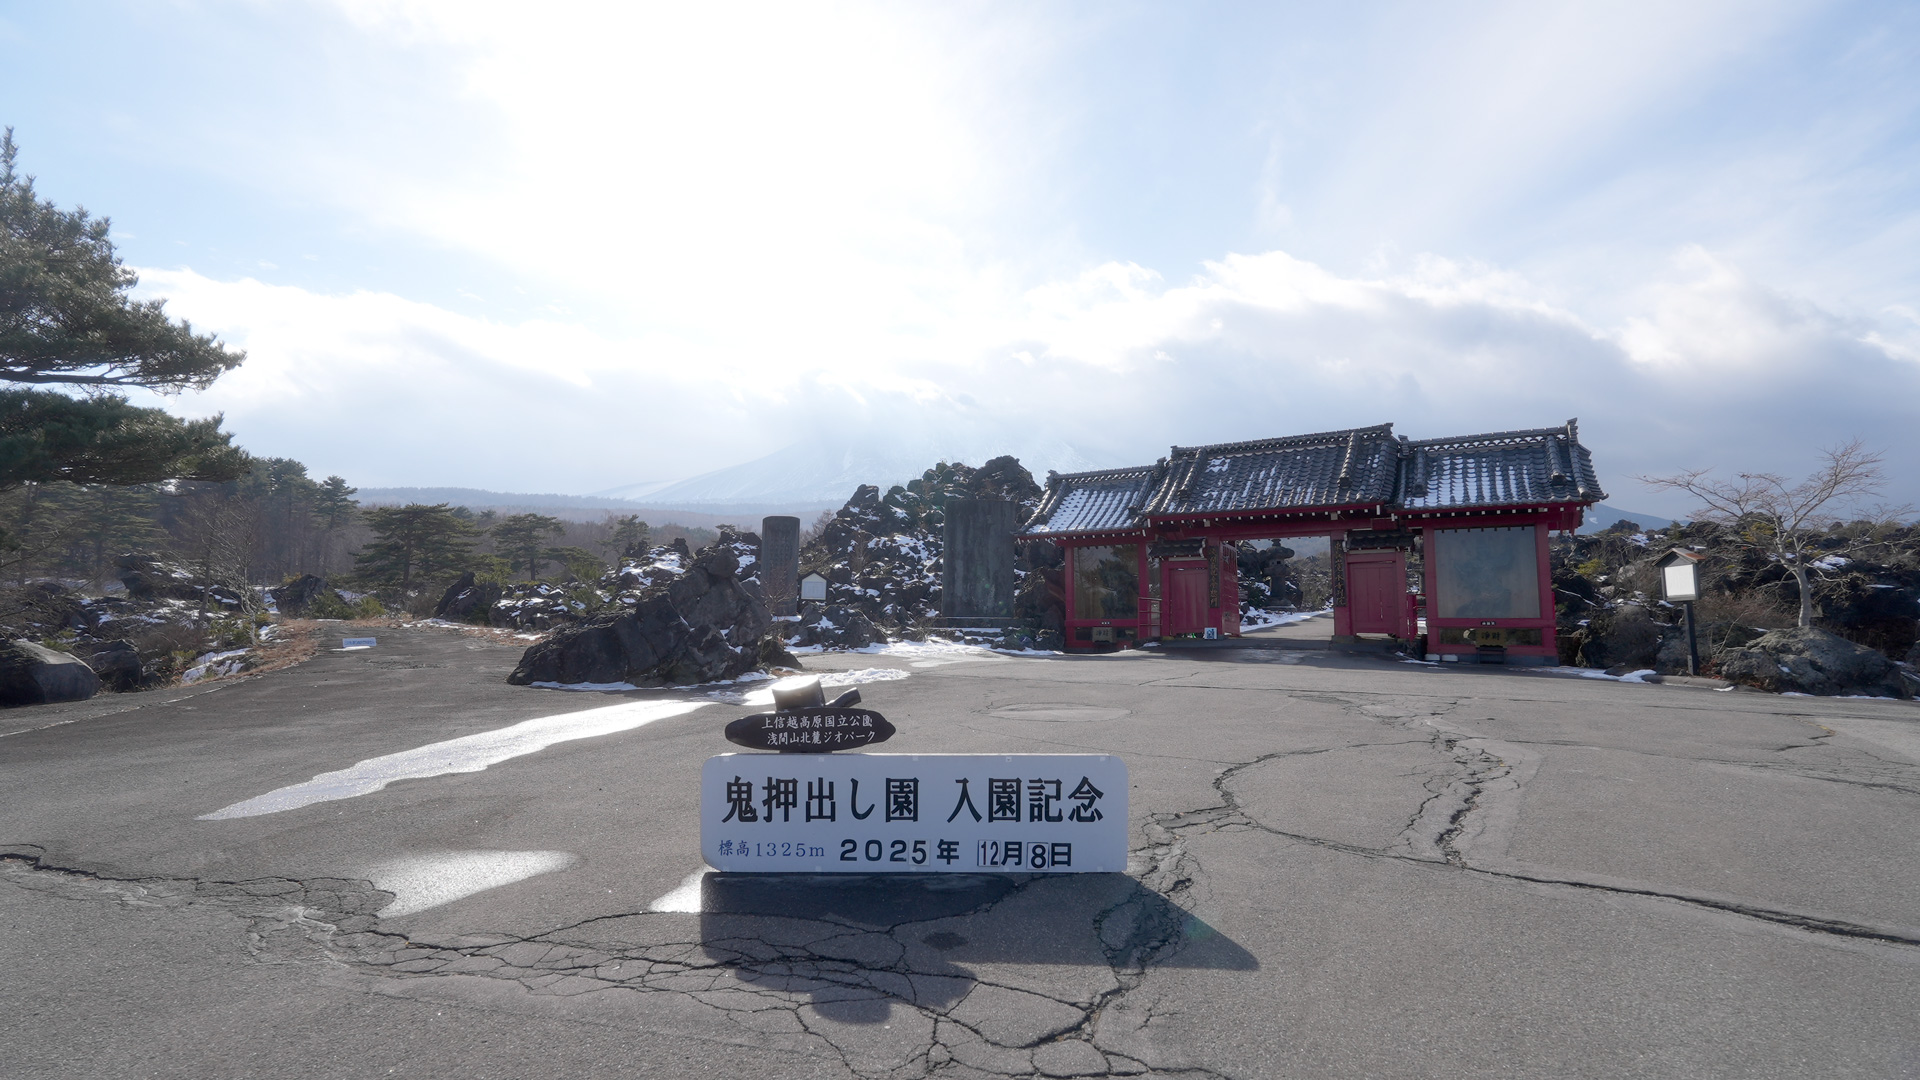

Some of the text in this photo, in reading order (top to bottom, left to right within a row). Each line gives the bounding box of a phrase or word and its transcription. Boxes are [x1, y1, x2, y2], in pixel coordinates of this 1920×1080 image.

[762, 714, 873, 729] 上信越高原国立公園
[767, 731, 876, 746] 浅間山北麓ジオパーク
[721, 775, 1105, 823] 鬼押出し園 入園記念
[718, 840, 825, 857] 標高1325m
[840, 838, 1072, 869] 2025年 12月8日
